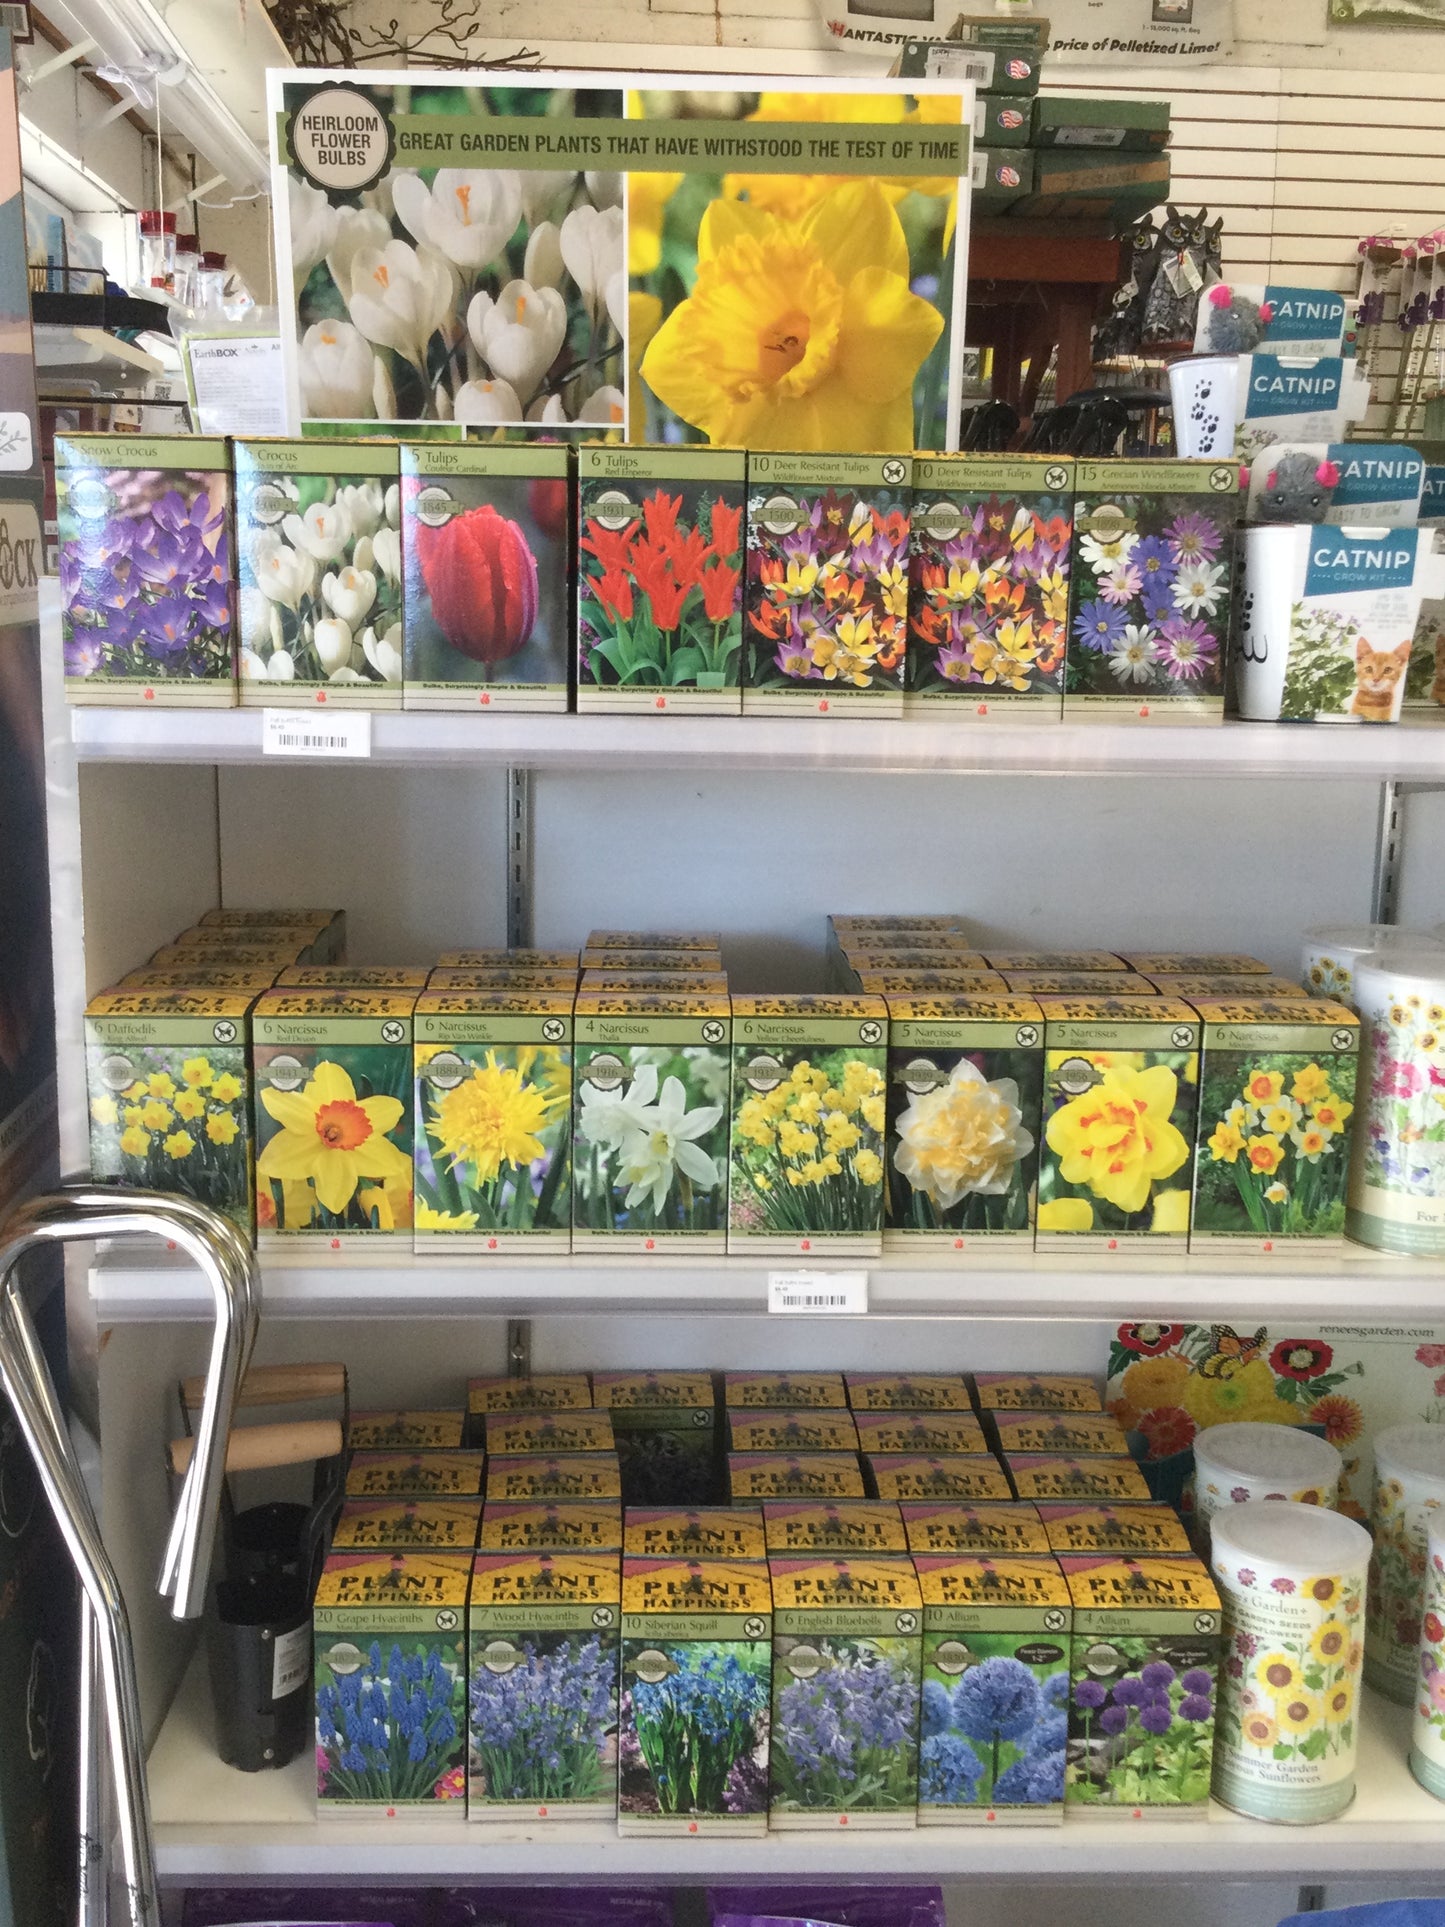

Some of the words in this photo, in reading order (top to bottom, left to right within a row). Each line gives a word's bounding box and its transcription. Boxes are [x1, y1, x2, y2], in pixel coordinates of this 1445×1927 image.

[1053, 38, 1088, 51] Price
[1092, 38, 1109, 50] of
[1110, 39, 1178, 54] Pelletized
[1179, 41, 1221, 55] Lime!
[302, 115, 379, 132] HEIRLOOM
[311, 133, 371, 149] FLOWER
[399, 132, 454, 151] GREAT
[460, 133, 529, 153] GARDEN
[535, 135, 602, 154] PLANTS
[607, 136, 649, 155] THAT
[655, 137, 698, 156] HAVE
[704, 138, 802, 158] WITHSTOOD
[808, 139, 839, 158] THE
[845, 140, 887, 159] TEST
[892, 141, 913, 159] OF
[918, 141, 959, 160] TIME
[318, 150, 367, 166] BULBS
[193, 348, 239, 359] EarthBOX
[1253, 376, 1336, 395] CATNIP
[80, 445, 112, 457] Snow
[117, 446, 158, 457] Crocus
[257, 450, 298, 462] Crocus
[412, 449, 420, 463] 5
[425, 451, 458, 467] Tulips
[591, 452, 601, 466] 6
[606, 455, 639, 470] Tulips
[754, 456, 770, 472] 10
[774, 460, 797, 471] Deer
[800, 461, 840, 471] Resistant
[843, 462, 870, 474] Tulips
[456, 465, 487, 474] Cardinal
[605, 468, 620, 476] Red
[621, 468, 653, 477] Emperor
[917, 463, 933, 479] 10
[937, 467, 961, 478] Deer
[963, 467, 1003, 478] Resistant
[1006, 468, 1032, 481] Tulips
[1081, 466, 1097, 481] 15
[1313, 548, 1411, 570] CATNIP
[1333, 572, 1369, 581] GROW
[1371, 573, 1386, 581] KIT
[107, 1006, 224, 1014] HAPPINESS
[276, 1006, 391, 1014] HAPPINESS
[912, 1010, 1023, 1018] HAPPINESS
[1066, 1011, 1178, 1019] HAPPINESS
[107, 1023, 156, 1034] Daffodils
[263, 1021, 272, 1034] 6
[277, 1024, 328, 1035] Narcissus
[425, 1018, 435, 1031] 6
[438, 1020, 487, 1031] Narcissus
[585, 1020, 594, 1032] 4
[599, 1023, 649, 1034] Narcissus
[743, 1020, 753, 1033] 6
[757, 1023, 805, 1034] Narcissus
[901, 1024, 911, 1037] 5
[915, 1027, 963, 1038] Narcissus
[1057, 1025, 1066, 1038] 5
[1070, 1028, 1118, 1038] Narcissus
[1216, 1027, 1225, 1040] 6
[1229, 1030, 1279, 1041] Narcissus
[1416, 1210, 1438, 1223] For
[1319, 1324, 1435, 1339] reneesgarden.com
[786, 1521, 885, 1536] PLANT
[787, 1536, 887, 1548] HAPPINESS
[340, 1575, 448, 1590] PLANT
[493, 1575, 601, 1589] PLANT
[644, 1580, 750, 1595] PLANT
[793, 1578, 899, 1592] PLANT
[940, 1576, 1045, 1590] PLANT
[1088, 1578, 1194, 1592] PLANT
[336, 1592, 445, 1603] HAPPINESS
[492, 1590, 600, 1602] HAPPINESS
[643, 1597, 751, 1609] HAPPINESS
[795, 1594, 903, 1605] HAPPINESS
[943, 1592, 1050, 1603] HAPPINESS
[1093, 1594, 1200, 1605] HAPPINESS
[1251, 1595, 1299, 1615] Garden
[316, 1611, 333, 1624] 20
[337, 1614, 369, 1626] Grape
[371, 1613, 424, 1625] Hyacinths
[480, 1609, 489, 1621] 7
[493, 1610, 526, 1622] Wood
[528, 1610, 580, 1623] Hyacinths
[785, 1613, 794, 1626] 6
[797, 1614, 833, 1628] English
[836, 1614, 882, 1626] Bluebells
[927, 1609, 943, 1622] 10
[946, 1611, 980, 1622] Allium
[1084, 1614, 1092, 1625] 4
[1096, 1615, 1130, 1626] Allium
[626, 1616, 641, 1629] 10
[645, 1619, 687, 1631] Siberian
[689, 1619, 718, 1633] Squill
[1279, 1620, 1311, 1629] SEEDS
[1276, 1762, 1318, 1772] Garden
[1258, 1769, 1321, 1784] Sunflowers
